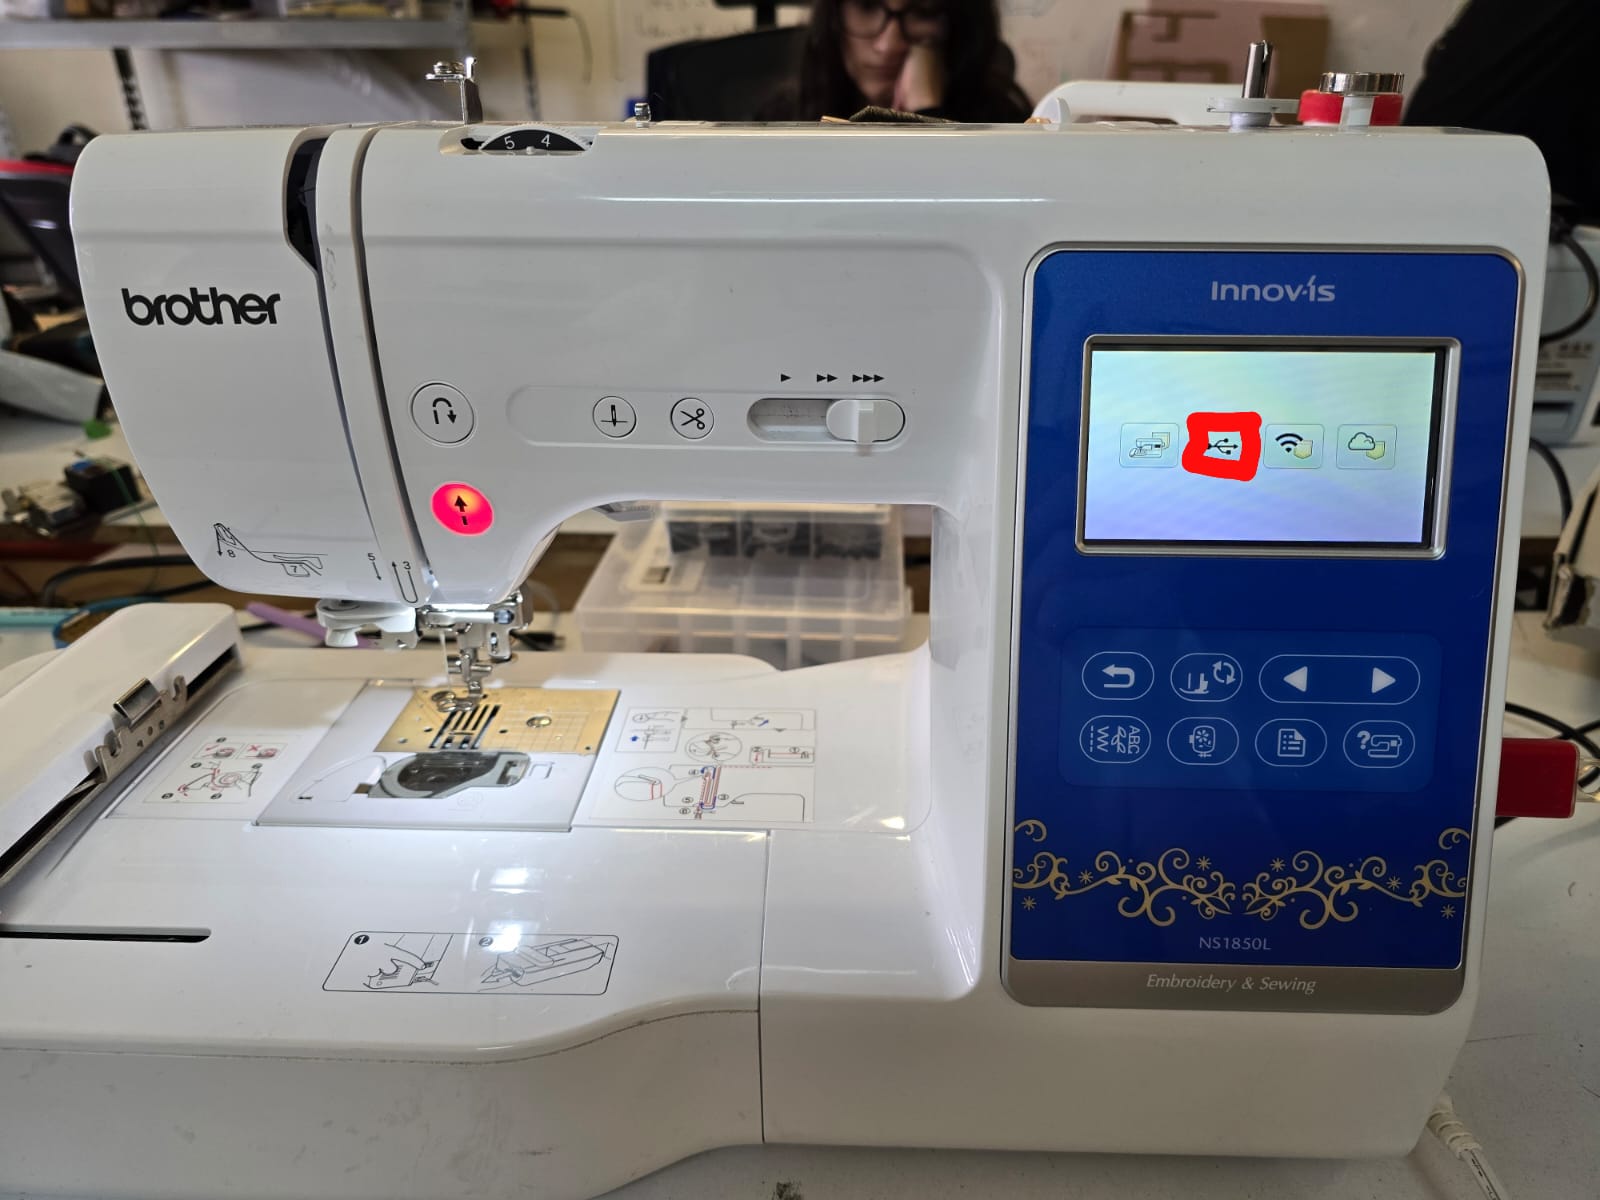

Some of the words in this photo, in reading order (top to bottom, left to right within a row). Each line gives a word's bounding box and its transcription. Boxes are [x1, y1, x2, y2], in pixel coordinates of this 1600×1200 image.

[504, 135, 515, 149] 5
[541, 134, 551, 147] 4
[121, 287, 281, 326] brother
[227, 549, 236, 558] 8
[367, 552, 377, 561] 5
[290, 565, 298, 573] 7
[403, 561, 412, 570] 3
[1128, 725, 1141, 754] ABC
[1199, 936, 1272, 950] NS1850L
[1146, 973, 1238, 993] Embroidery
[1241, 976, 1255, 990] &
[1259, 976, 1318, 995] Sewing
